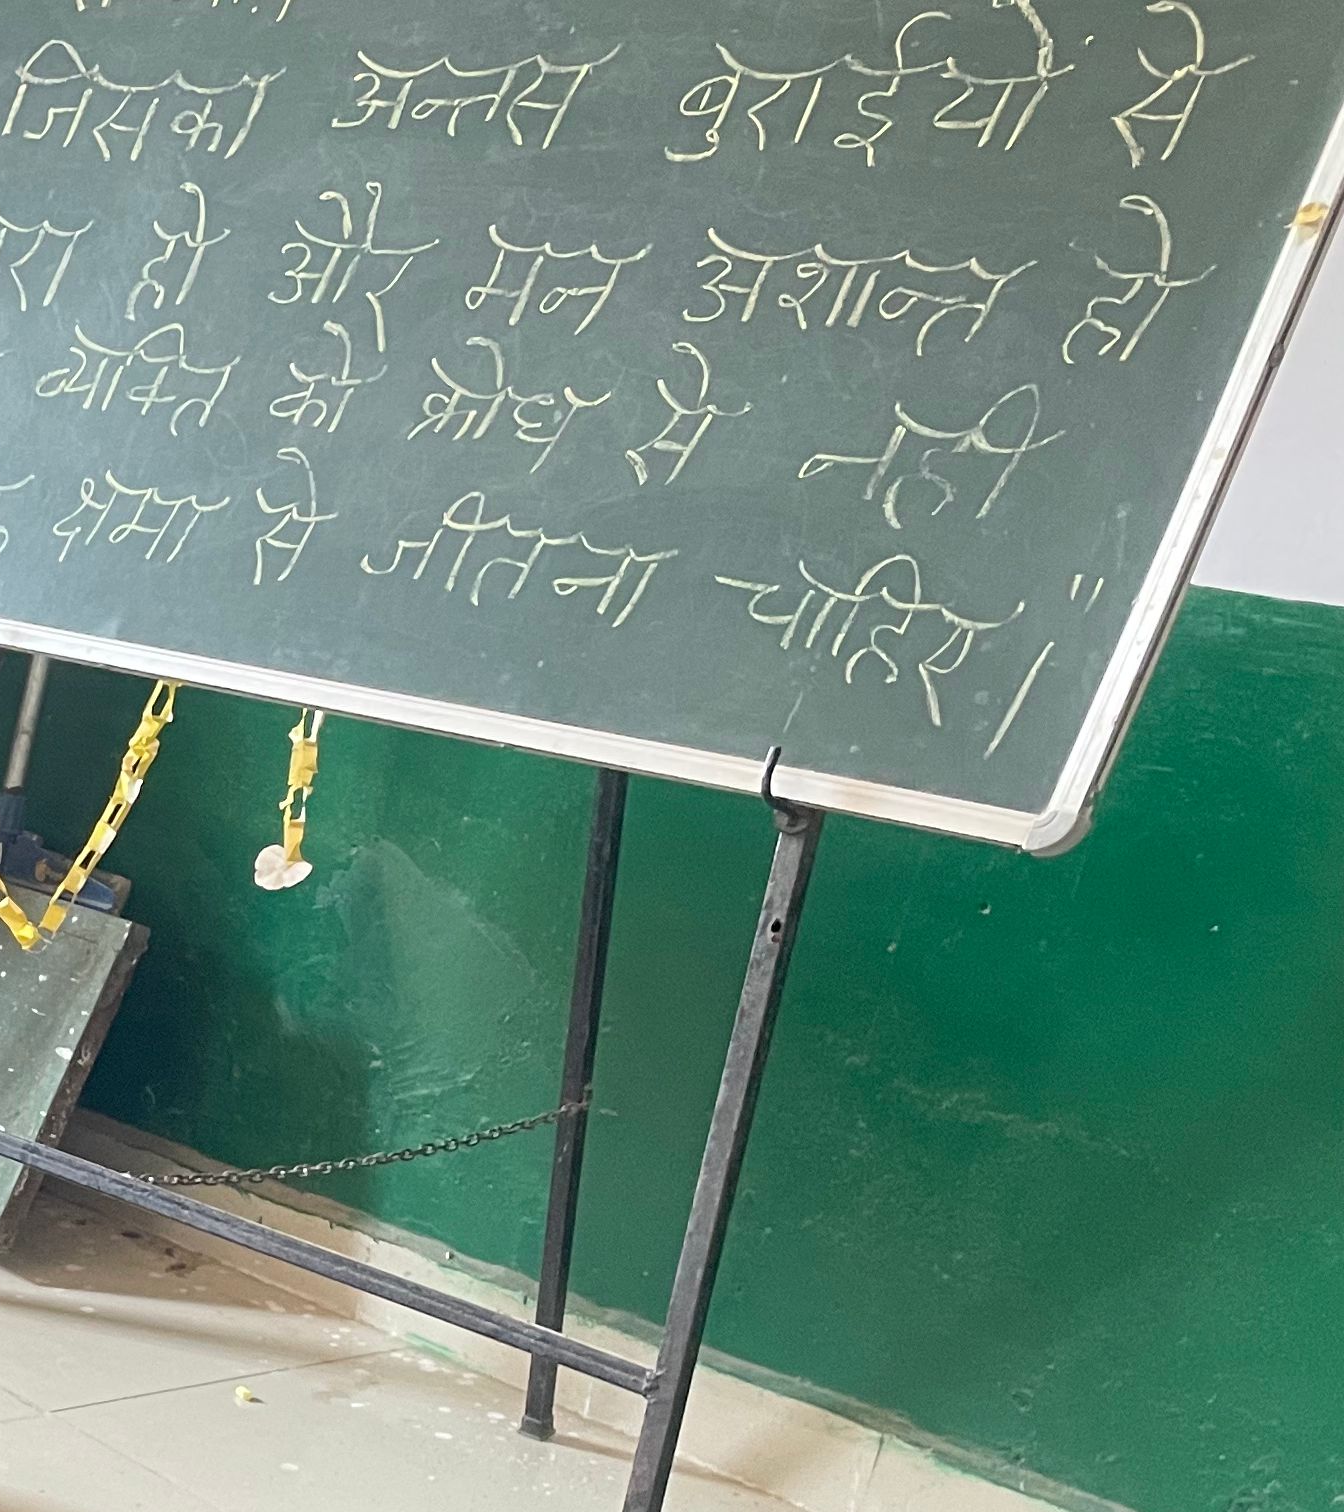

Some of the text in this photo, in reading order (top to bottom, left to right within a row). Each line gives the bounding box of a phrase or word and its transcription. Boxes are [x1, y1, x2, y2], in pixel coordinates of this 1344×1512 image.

[1, 39, 288, 163] जिसका
[1110, 0, 1257, 170] से
[124, 181, 232, 322] हो
[464, 224, 655, 339] मन
[681, 227, 1040, 358] अशान्त
[1061, 194, 1218, 365] हो
[269, 321, 388, 433] को
[626, 342, 754, 486] से
[253, 447, 339, 586] से
[359, 490, 679, 628] जीतना
